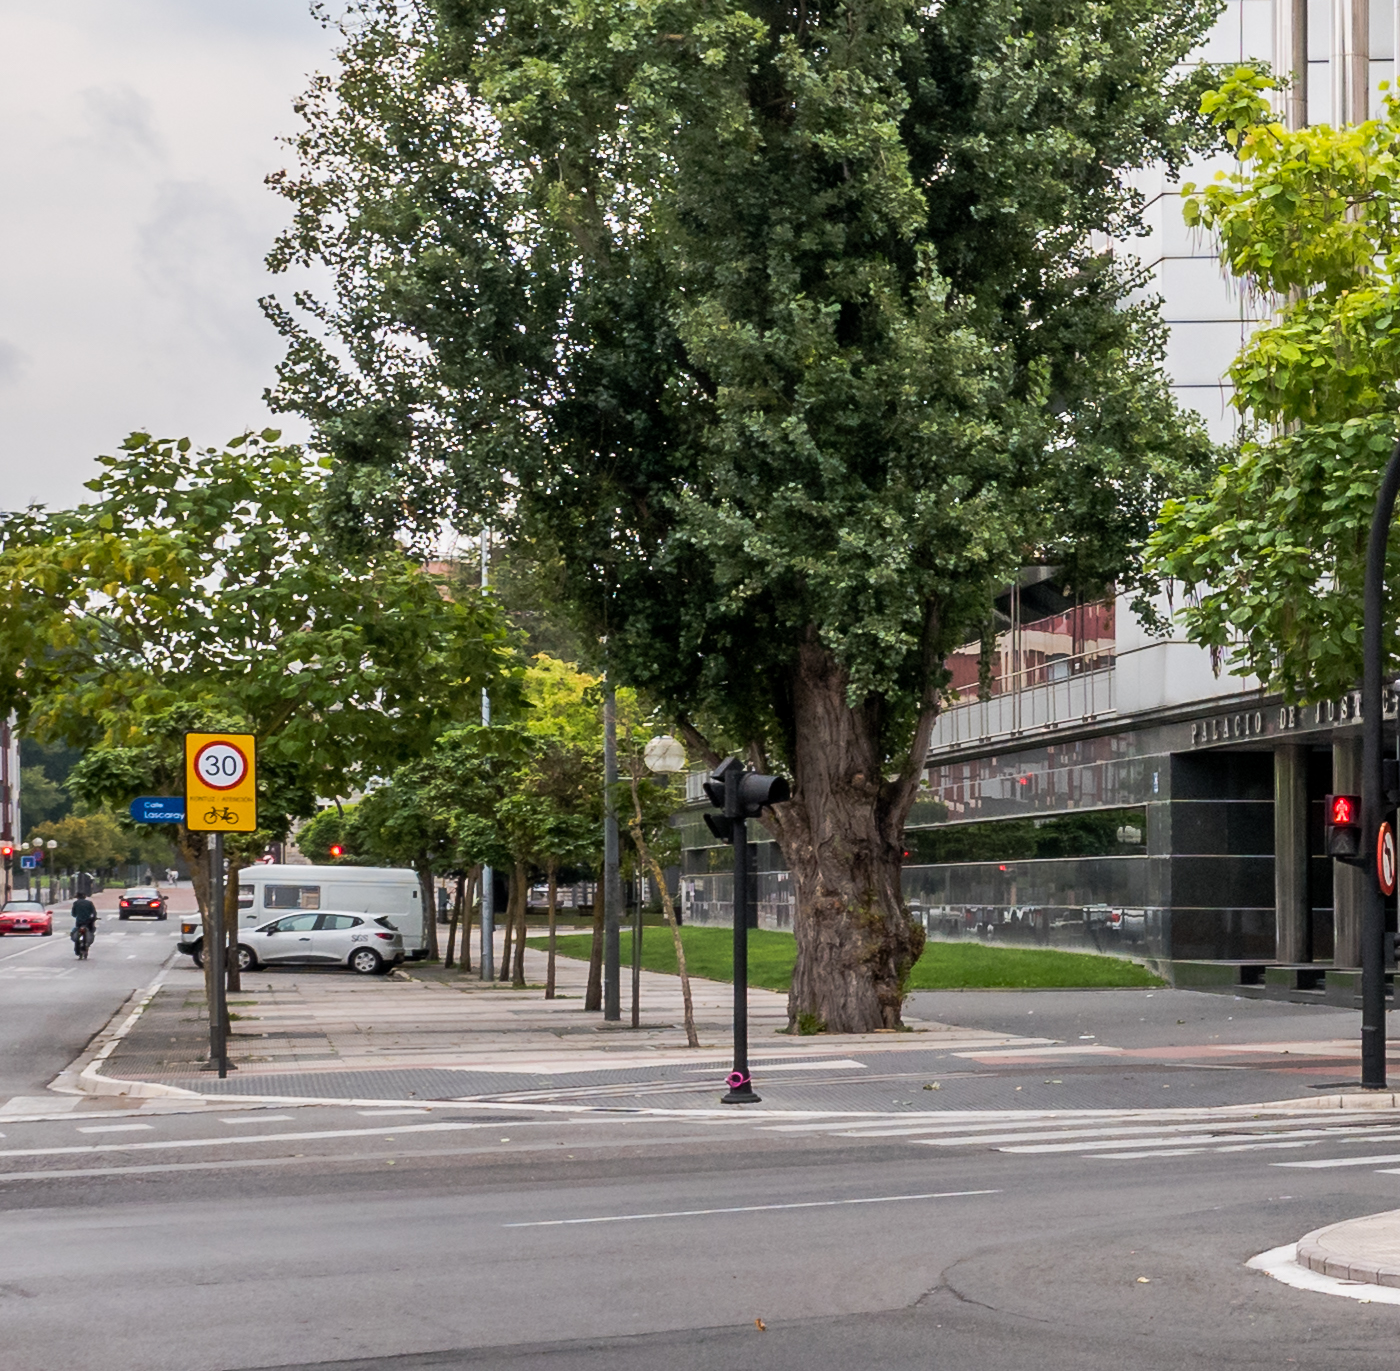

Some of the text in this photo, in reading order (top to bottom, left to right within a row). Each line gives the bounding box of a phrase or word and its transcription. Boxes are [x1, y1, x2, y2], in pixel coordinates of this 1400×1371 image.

[1190, 685, 1400, 745] PALACIO DE JUSTC
[204, 754, 237, 777] 30
[143, 801, 164, 809] Calle
[143, 810, 186, 821] Lascaray
[351, 934, 369, 943] SGS
